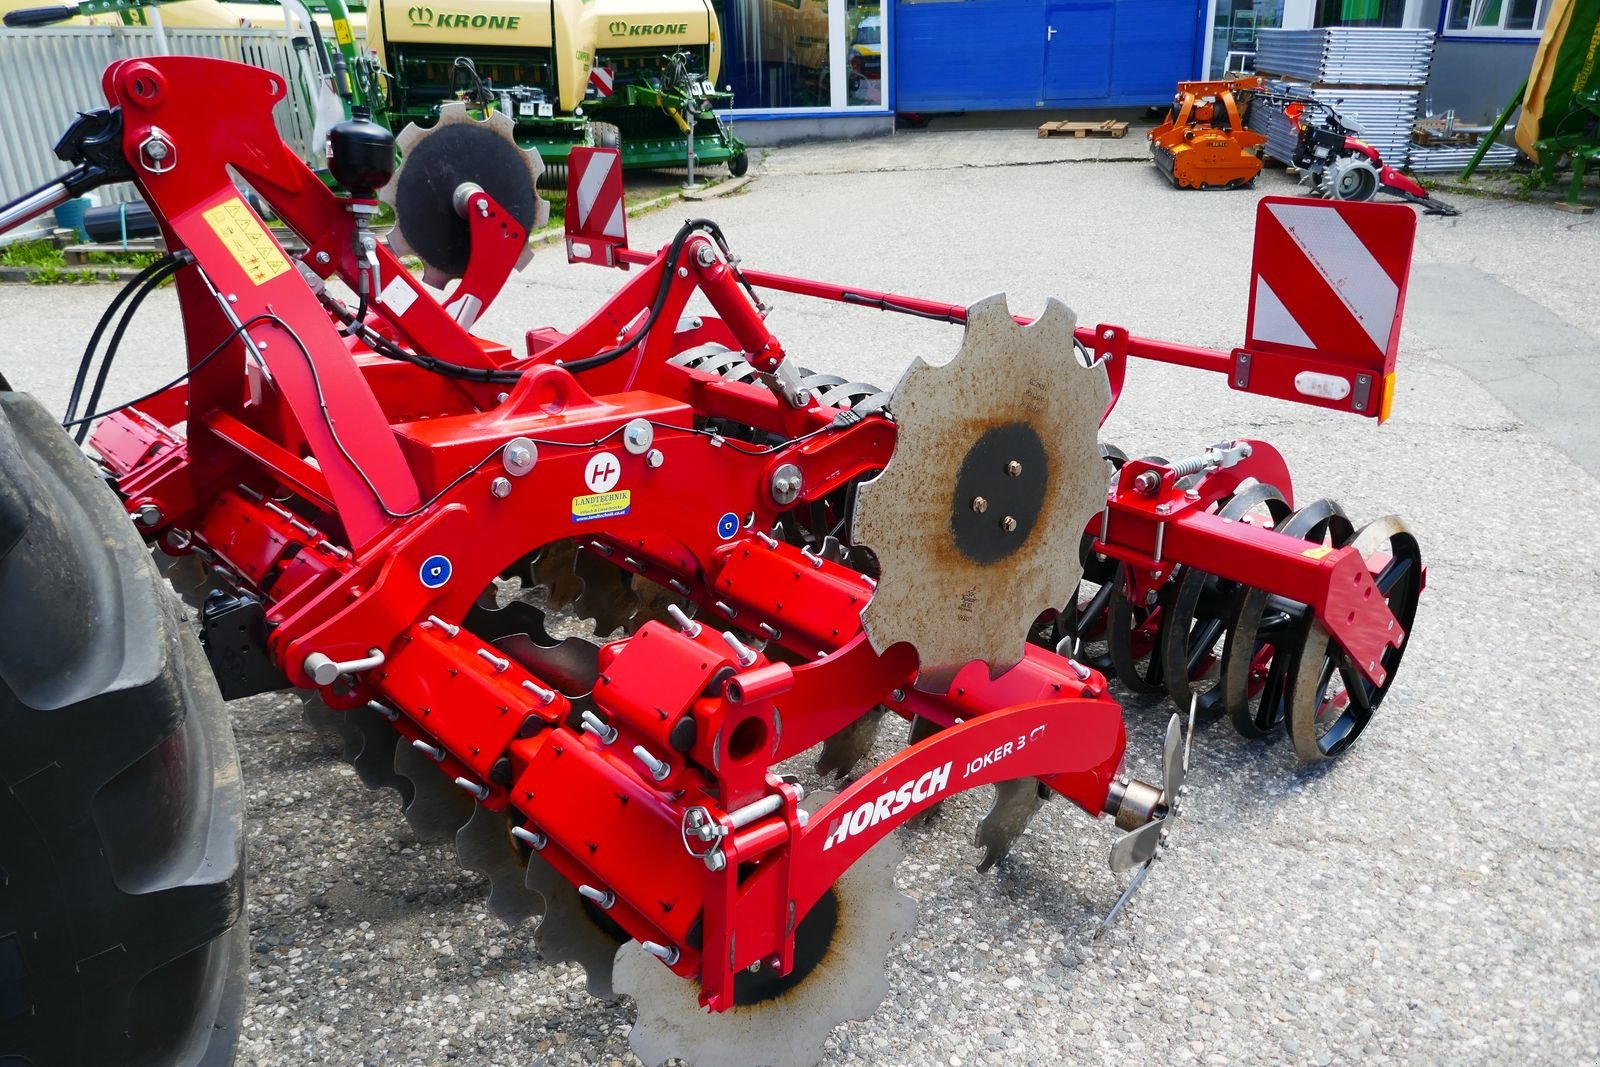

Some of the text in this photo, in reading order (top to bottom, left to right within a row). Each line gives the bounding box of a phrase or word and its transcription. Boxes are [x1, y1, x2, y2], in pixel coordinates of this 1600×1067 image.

[437, 13, 521, 30] KRONE
[629, 23, 688, 36] KRONE
[575, 492, 628, 506] LANDTECHNIK
[963, 741, 1013, 778] JOKER
[1016, 735, 1026, 751] 3
[823, 761, 953, 851] HORSCH
